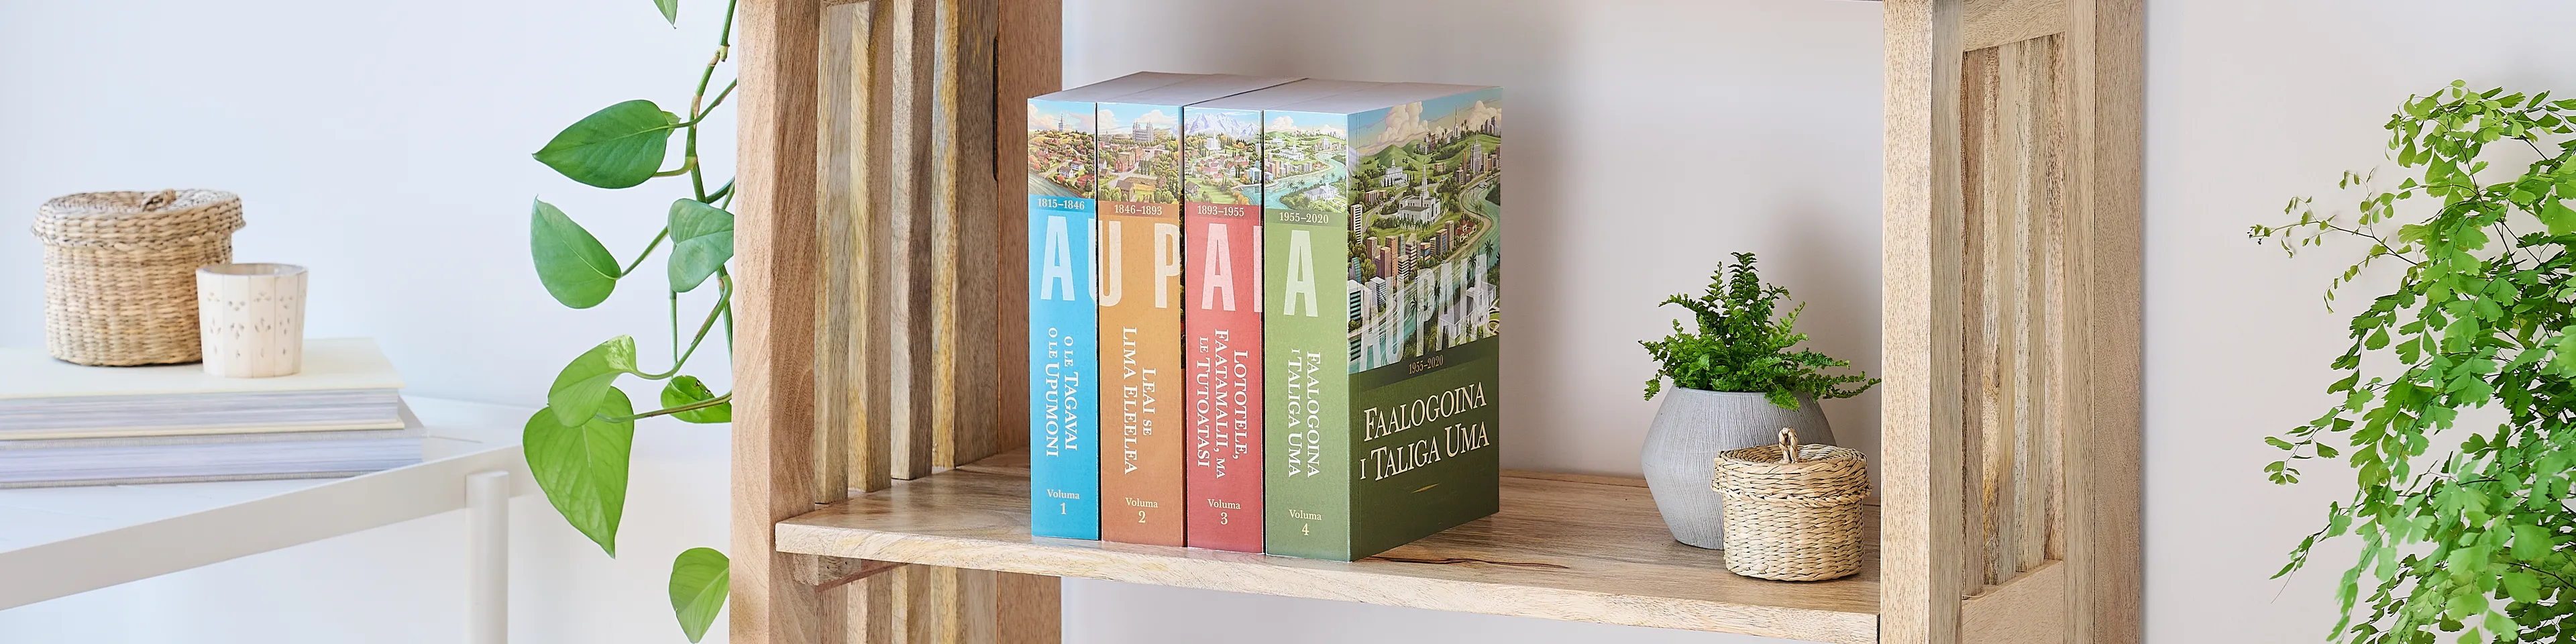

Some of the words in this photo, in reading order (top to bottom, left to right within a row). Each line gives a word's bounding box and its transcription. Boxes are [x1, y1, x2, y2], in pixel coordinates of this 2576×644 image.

[1036, 197, 1085, 211] 1815–1846
[1114, 204, 1163, 217] 1846–1893
[1197, 205, 1245, 218] 1893–1955
[1279, 211, 1330, 225] 1955–2020
[1123, 326, 1137, 379] LIMA
[1409, 354, 1444, 374] 1955–2020
[1142, 368, 1157, 415] LEAI
[1213, 329, 1229, 452] FAATAMALII,
[1287, 356, 1301, 428] TALIGA
[1046, 362, 1060, 458] UPUMONI
[1064, 370, 1079, 451] TAGAVAI
[1196, 358, 1211, 468] TUTOATASI
[1232, 350, 1248, 460] LOTOTELE,
[1306, 352, 1321, 478] FAALOGOINA
[1364, 381, 1487, 442] FAALOGOINA
[1123, 386, 1138, 475] ELEELEA
[1142, 419, 1152, 436] SE
[1287, 432, 1301, 478] UMA
[1371, 436, 1441, 481] TALIGA
[1445, 421, 1490, 458] UMA
[1216, 458, 1226, 479] MA
[1046, 488, 1080, 500] Voluma
[1125, 498, 1159, 508] Voluma
[1061, 503, 1067, 515] 1
[1208, 499, 1241, 510] Voluma
[1138, 511, 1146, 523] 2
[1220, 513, 1228, 525] 3
[1289, 509, 1322, 521] Voluma
[1301, 524, 1309, 536] 4
